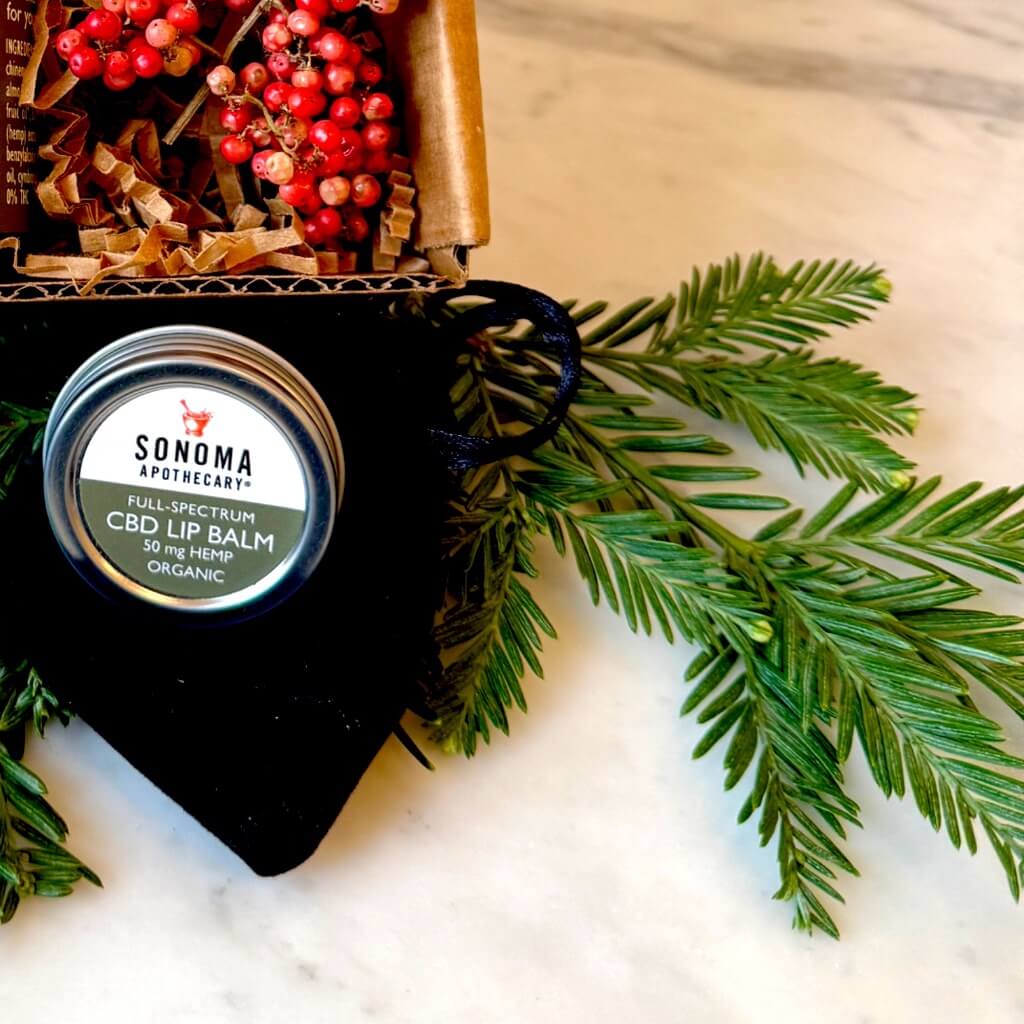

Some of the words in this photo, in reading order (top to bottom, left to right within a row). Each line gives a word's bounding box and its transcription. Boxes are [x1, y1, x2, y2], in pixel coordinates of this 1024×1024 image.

[6, 1, 22, 22] for
[135, 434, 251, 476] SONOMA
[128, 495, 255, 524] FULL-SPECTRUM
[106, 511, 159, 534] CBD
[167, 519, 201, 541] LIP
[208, 525, 274, 553] BALM
[143, 538, 160, 553] 50
[164, 543, 185, 559] mg
[190, 546, 233, 563] HEMP
[147, 560, 225, 583] ORGANIC
